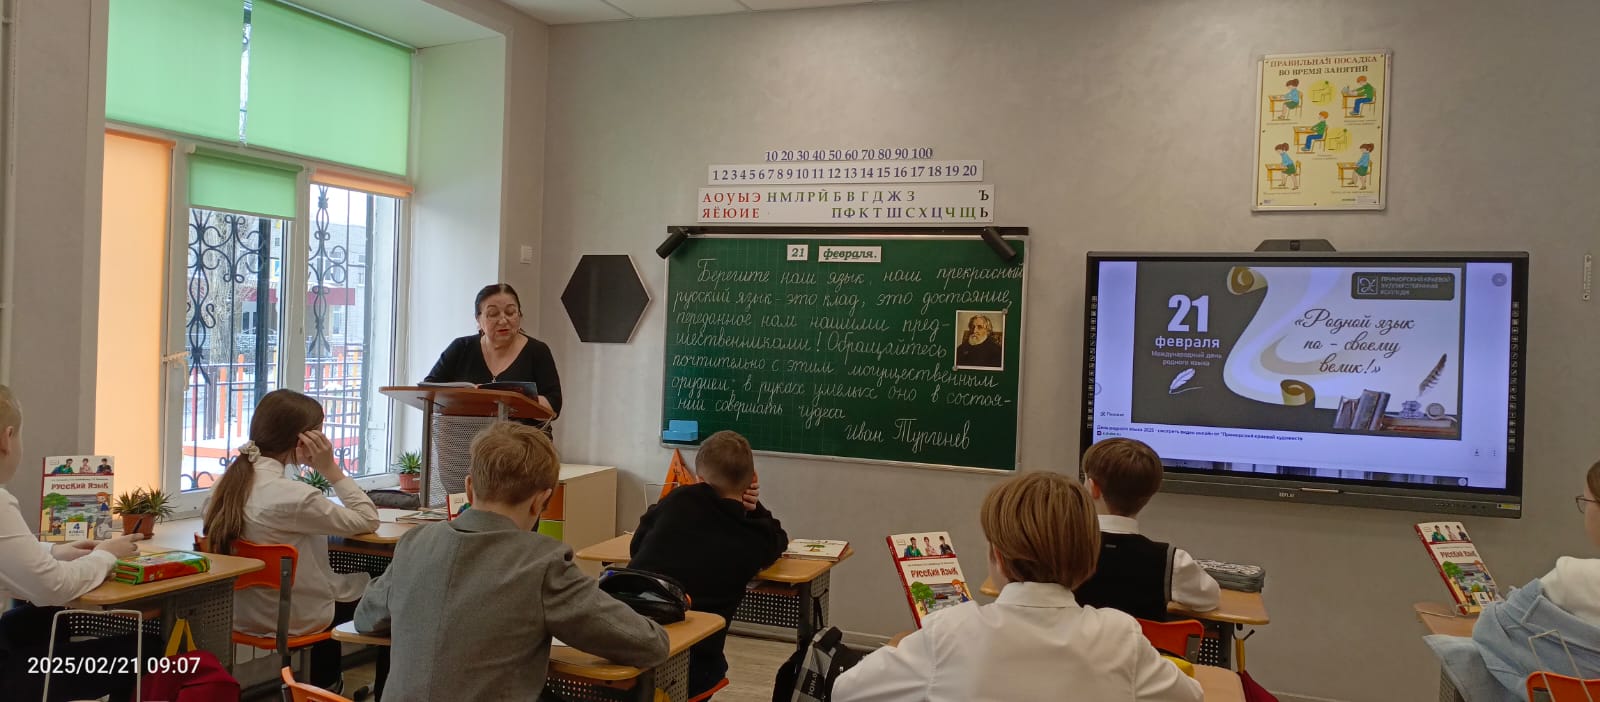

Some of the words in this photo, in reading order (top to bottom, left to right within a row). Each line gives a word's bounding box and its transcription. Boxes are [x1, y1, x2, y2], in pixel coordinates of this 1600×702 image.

[1270, 58, 1331, 67] ПРАВИЛЬНАЯ
[1334, 55, 1377, 64] ПОСАДКА
[1292, 68, 1322, 76] ВРЕМЯ
[1324, 65, 1368, 74] ЗАНЯТИЙ
[766, 150, 778, 162] 10
[781, 150, 794, 161] 20
[797, 150, 810, 160] 30
[812, 150, 826, 160] 40
[829, 150, 842, 160] 50
[845, 150, 858, 160] 60
[862, 149, 874, 160] 70
[878, 148, 892, 160] 80
[894, 148, 908, 159] 90
[912, 148, 933, 159] 100
[713, 170, 718, 180] 1
[722, 170, 728, 180] 2
[731, 170, 738, 180] 3
[740, 170, 746, 180] 4
[749, 170, 756, 180] 5
[758, 169, 766, 180] 6
[768, 169, 774, 179] 7
[776, 169, 784, 179] 8
[786, 168, 793, 179] 9
[796, 168, 808, 179] 10
[812, 168, 824, 178] 11
[828, 168, 841, 178] 12
[844, 168, 858, 178] 13
[860, 168, 874, 178] 14
[878, 167, 891, 178] 15
[894, 167, 908, 178] 16
[911, 166, 926, 177] 17
[929, 166, 942, 176] 18
[946, 166, 960, 176] 19
[962, 165, 978, 176] 20
[791, 248, 804, 258] 21
[823, 248, 878, 260] февраля.
[697, 258, 770, 290] Берегите
[780, 271, 817, 285] наш
[883, 269, 922, 283] наш
[936, 263, 1024, 290] прекрасный
[673, 287, 731, 312] русский
[786, 293, 818, 306] это
[876, 292, 914, 306] это
[920, 290, 1013, 316] достояние,
[1168, 294, 1209, 332] 21
[675, 311, 752, 333] переданное
[761, 314, 797, 328] нам
[810, 316, 890, 332] нашими
[902, 318, 950, 342] пред-
[1294, 308, 1372, 334] «Родной
[1374, 318, 1416, 336] язык
[827, 331, 947, 365] Обращайтесь
[1154, 336, 1220, 350] февраля
[1303, 340, 1322, 350] по
[1344, 331, 1401, 358] своему
[672, 353, 766, 371] почтительно
[771, 360, 780, 372] с
[787, 359, 834, 374] этим
[848, 362, 999, 388] могущественным
[1319, 352, 1382, 374] велик!»
[744, 374, 752, 392] в
[757, 381, 806, 401] руках
[813, 383, 879, 407] умелых
[888, 386, 918, 401] оно
[931, 384, 940, 403] в
[677, 398, 706, 411] нии
[715, 389, 784, 421] совершать
[798, 405, 846, 430] чудеса
[843, 420, 884, 443] Иван
[893, 418, 971, 453] Тургенев
[910, 568, 940, 578] РУССКИЙ
[940, 567, 958, 576] ЯЗЫК
